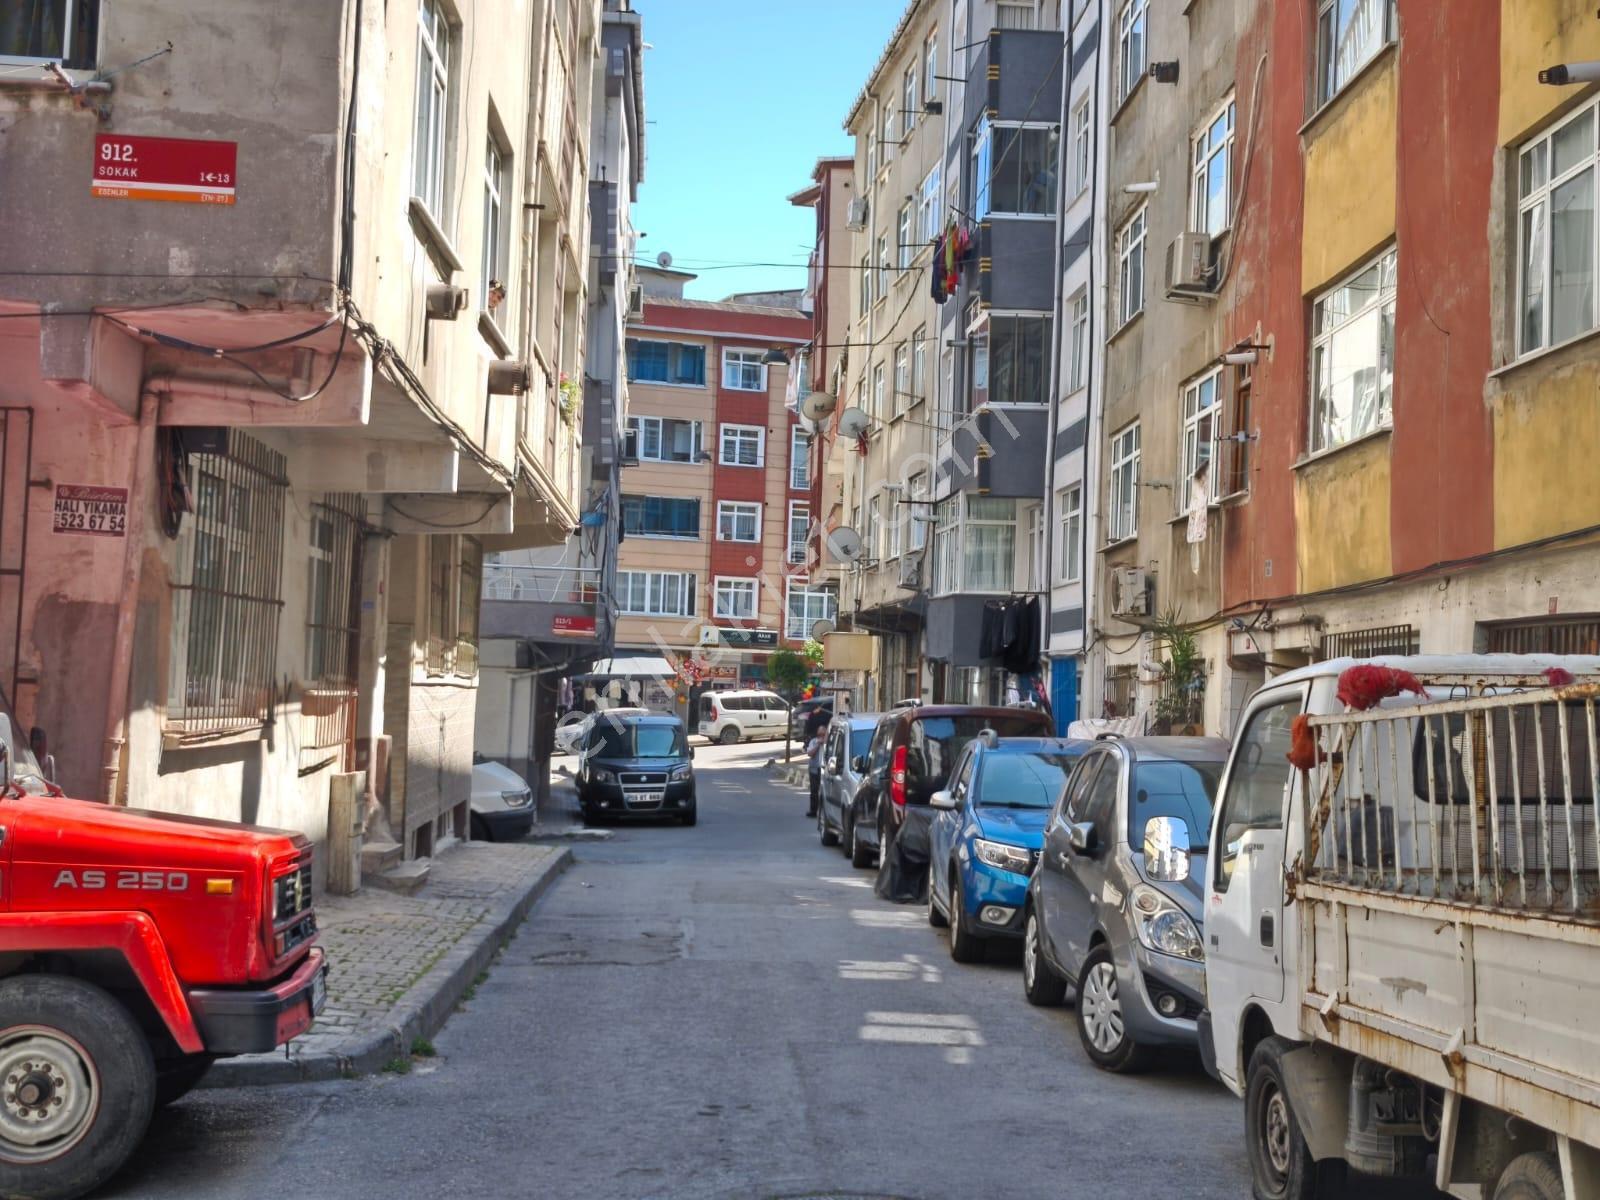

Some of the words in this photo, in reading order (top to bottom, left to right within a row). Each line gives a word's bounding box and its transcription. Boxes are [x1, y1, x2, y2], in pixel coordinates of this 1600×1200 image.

[101, 143, 138, 162] 912.
[99, 166, 138, 177] SOKAK
[83, 501, 126, 516] YIKAMA
[61, 513, 84, 529] 523
[89, 515, 106, 530] 67
[109, 516, 125, 531] 54
[53, 870, 106, 888] AS
[117, 871, 188, 891] 250
